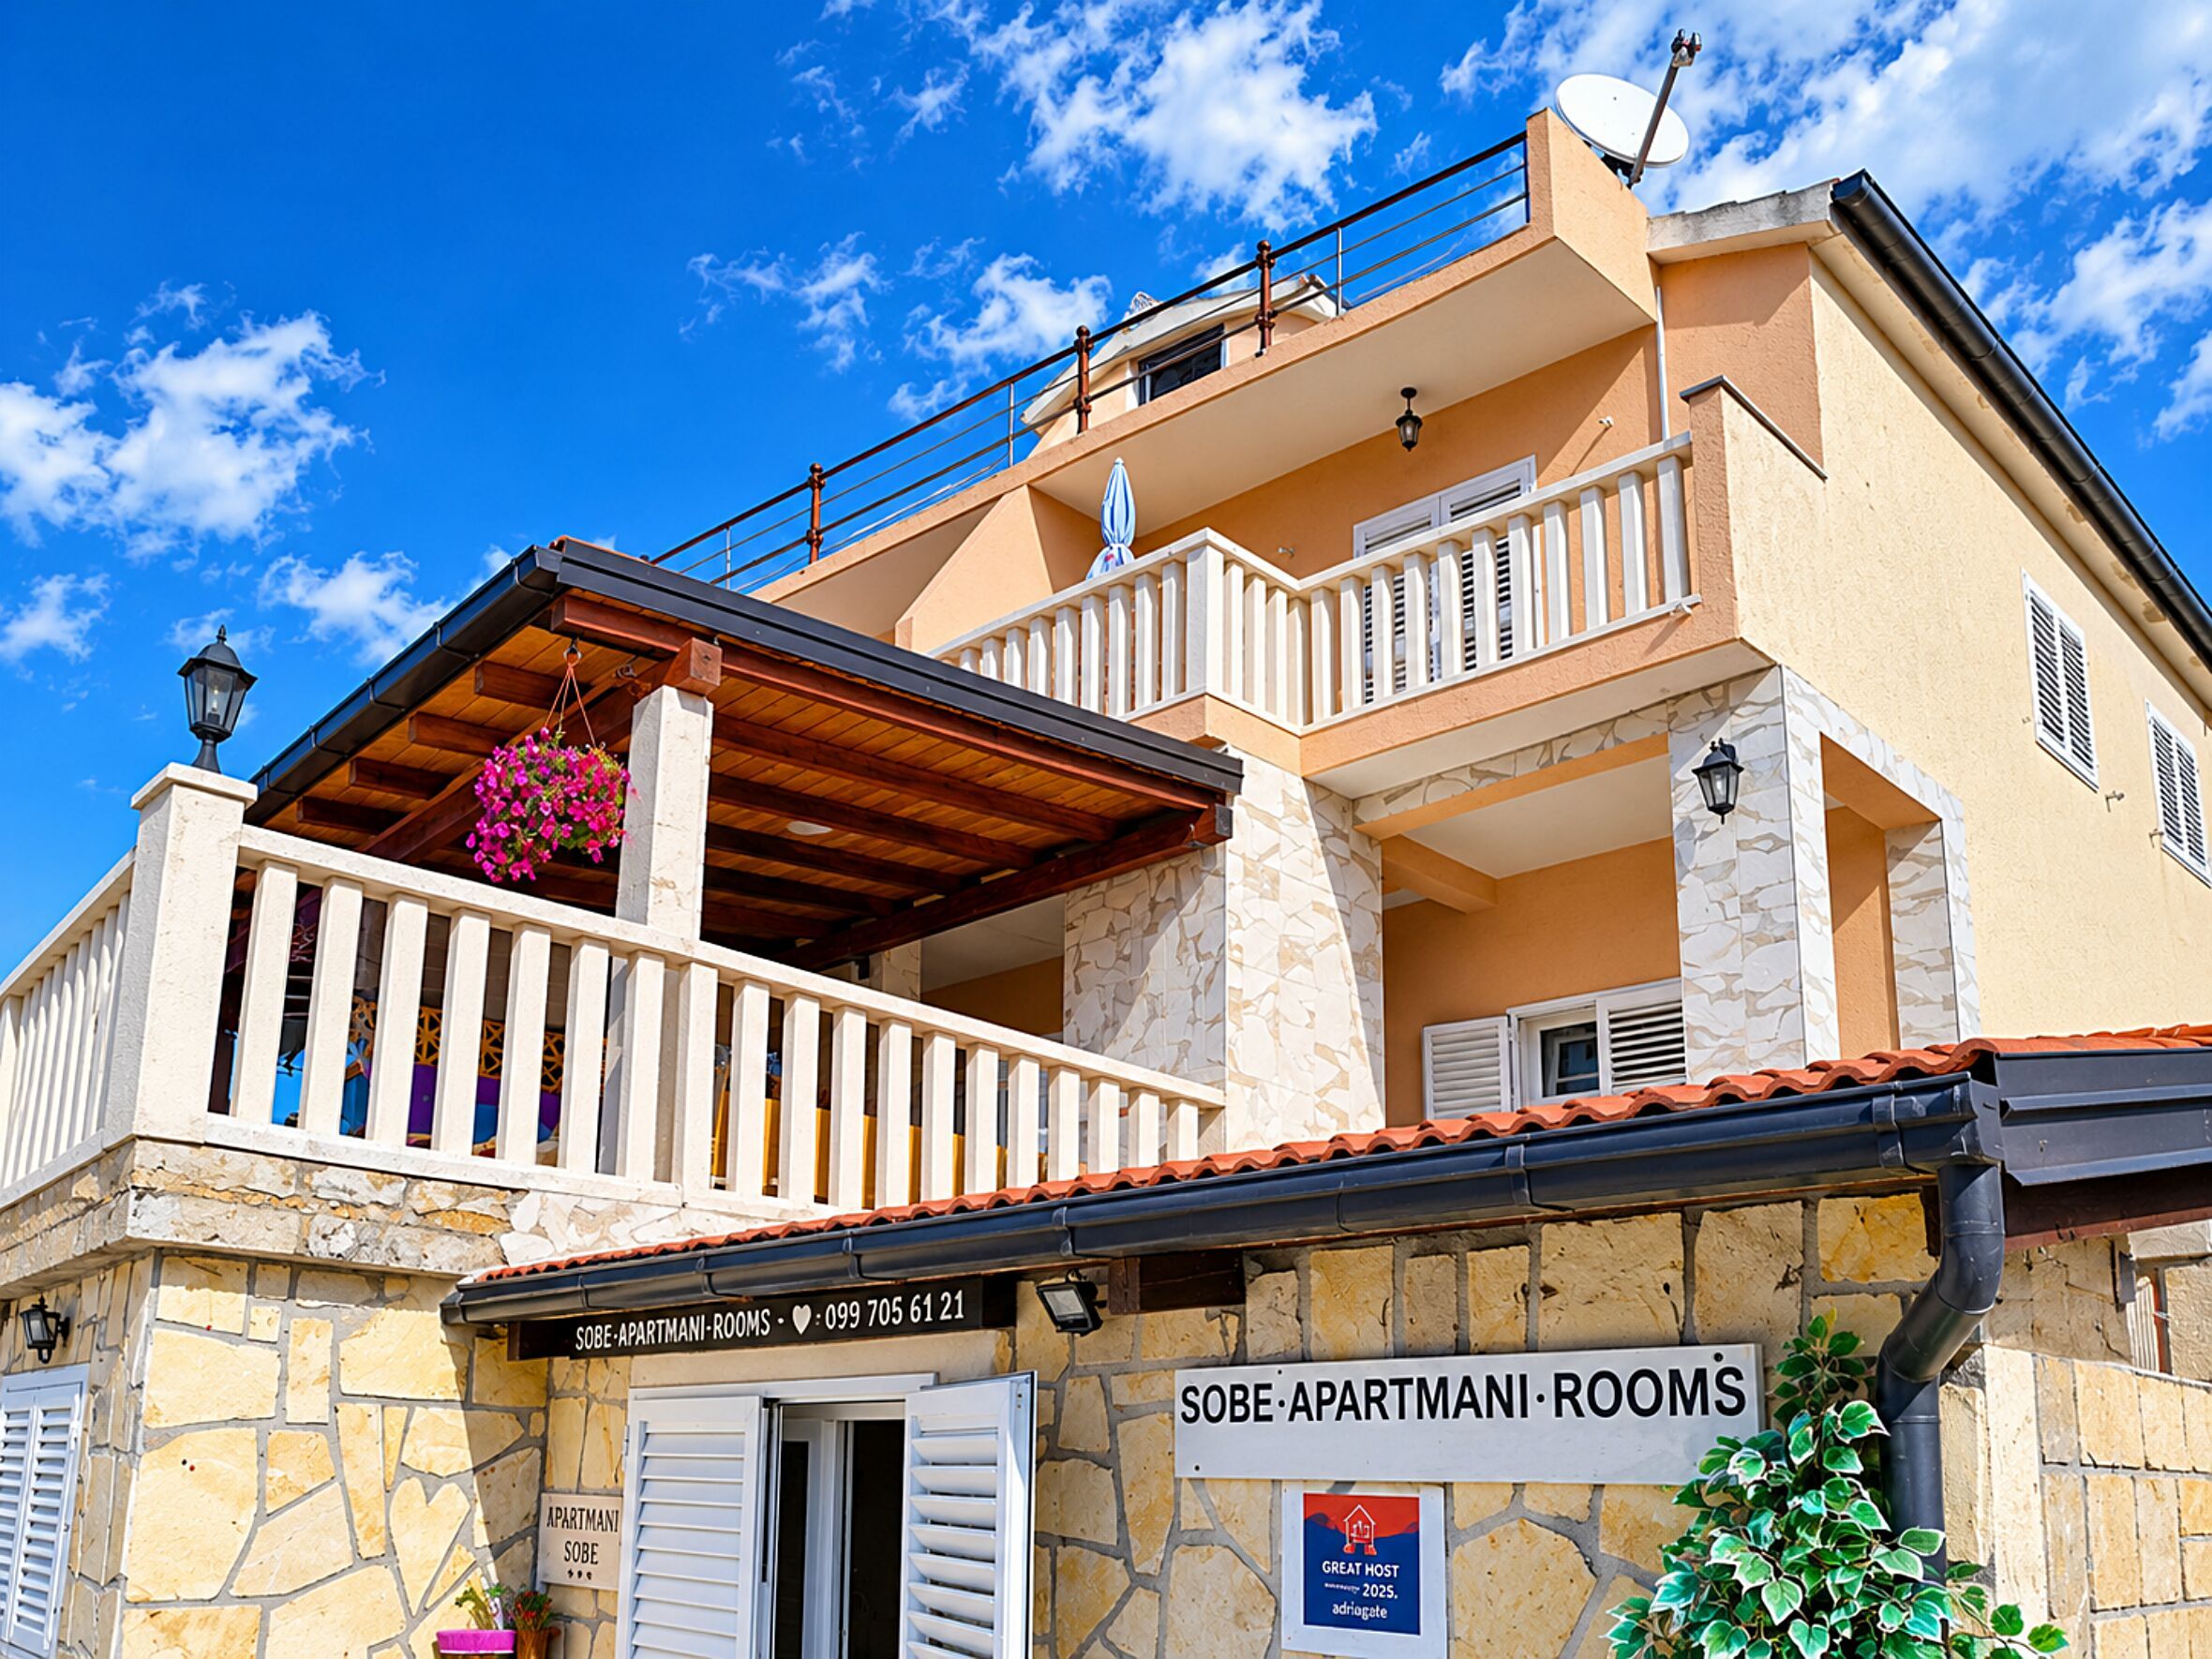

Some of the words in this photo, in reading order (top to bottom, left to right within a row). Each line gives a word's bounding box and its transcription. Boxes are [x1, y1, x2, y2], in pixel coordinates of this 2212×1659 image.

[867, 1296, 903, 1326] 705
[910, 1293, 934, 1323] 61
[939, 1290, 964, 1320] 21
[546, 1505, 619, 1532] APARTMANI
[564, 1540, 599, 1565] SOBE
[1322, 1561, 1362, 1576] GREAT
[1365, 1563, 1399, 1578] HOST
